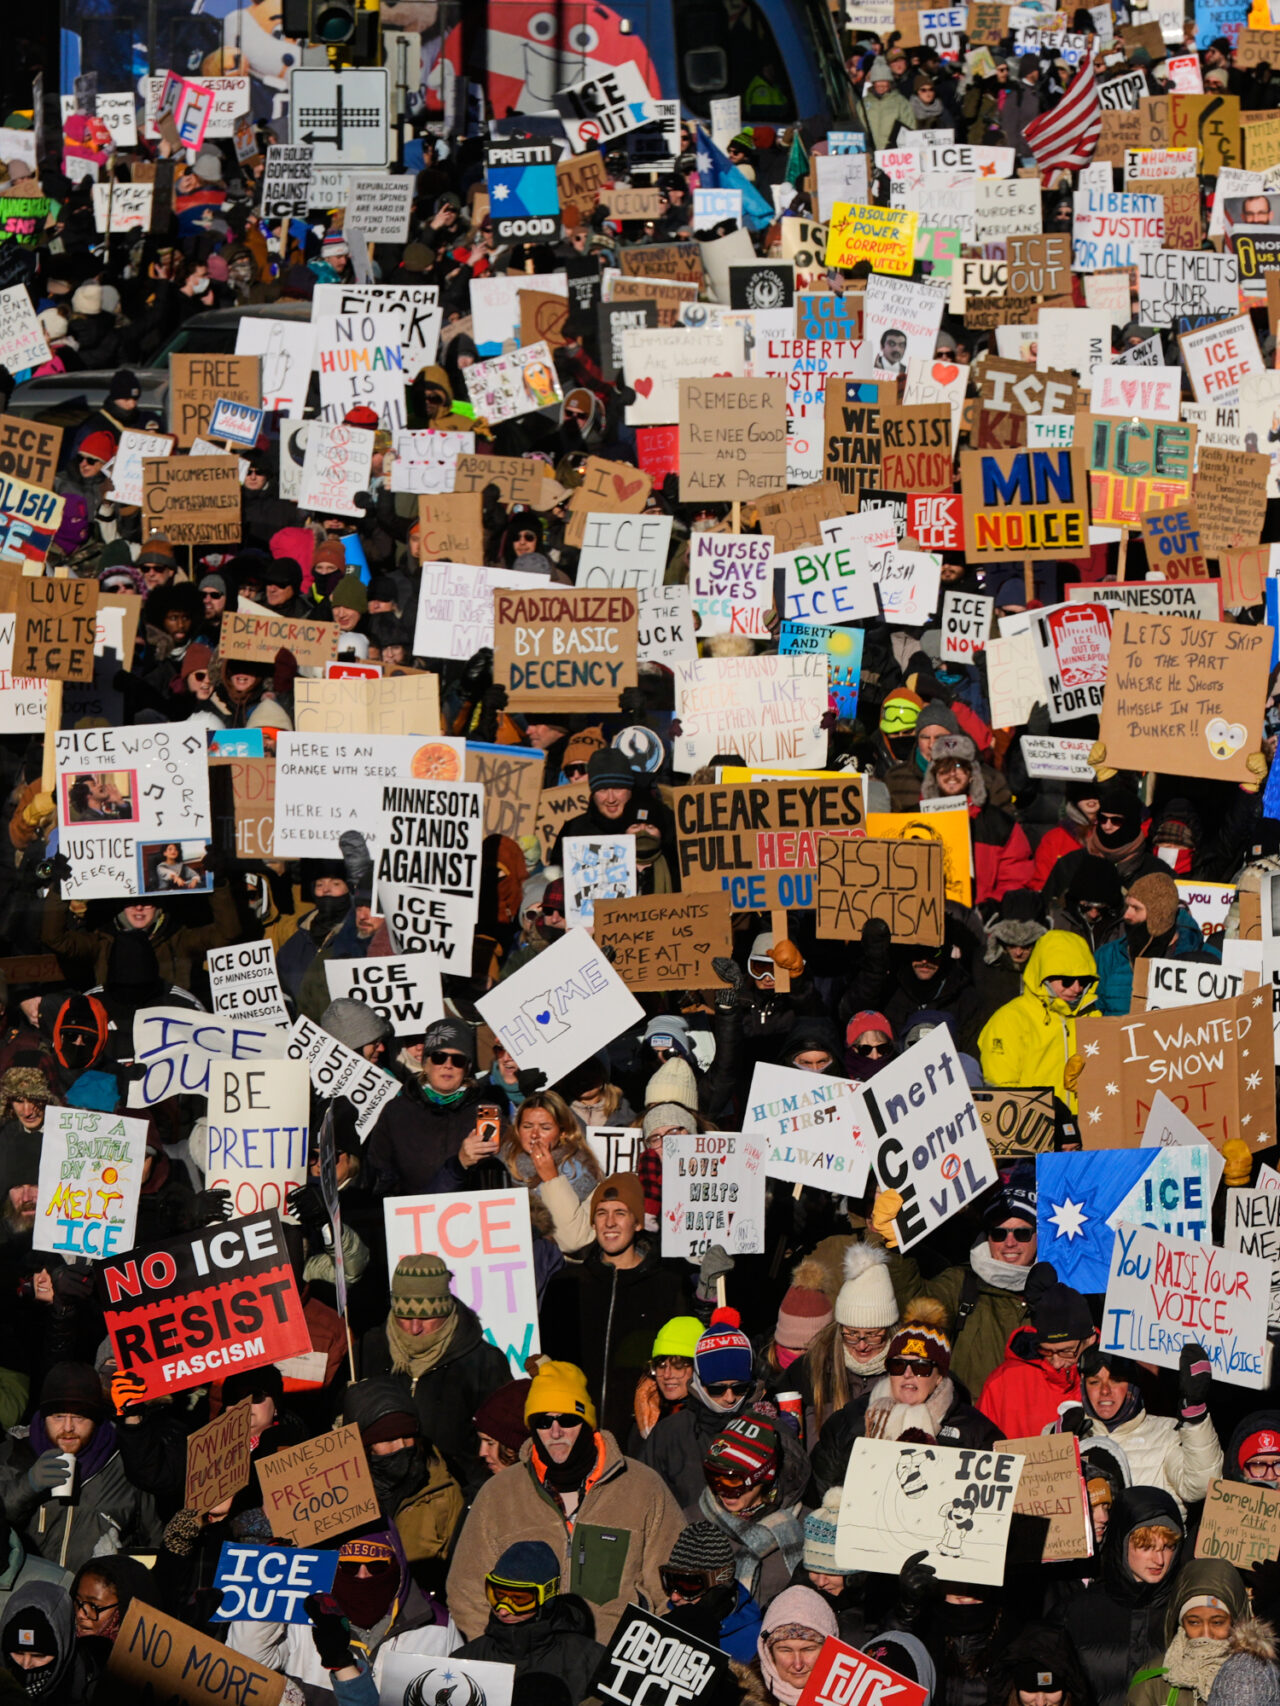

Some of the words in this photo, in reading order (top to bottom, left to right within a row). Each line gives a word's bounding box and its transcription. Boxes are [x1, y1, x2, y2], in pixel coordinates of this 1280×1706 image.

[1102, 74, 1147, 109] STOP
[488, 146, 552, 165] PRETTI
[932, 148, 972, 168] ICE
[267, 163, 311, 178] GOPHERS
[265, 183, 308, 199] AGAINST
[357, 183, 409, 191] REPUBLICANS
[264, 202, 307, 216] ICE
[1089, 192, 1156, 212] LIBERTY
[499, 219, 555, 237] GOOD
[1092, 217, 1165, 238] JUSTICE
[1010, 239, 1064, 267] ICE
[1073, 241, 1100, 267] FOR
[1102, 241, 1136, 267] ALL
[1011, 267, 1060, 294] OUT
[1140, 253, 1178, 278] ICE
[1180, 253, 1237, 283] MELTS
[335, 316, 375, 343] NO
[320, 345, 402, 374] HUMAN
[768, 340, 862, 359] LIBERTY
[1204, 339, 1239, 366] ICE
[190, 359, 240, 387] FREE
[1204, 361, 1252, 394] FREE
[687, 387, 773, 410] REMEBER
[690, 423, 744, 443] RENEE
[747, 422, 784, 443] GOOD
[883, 418, 951, 448] RESIST
[716, 448, 746, 461] AND
[687, 473, 729, 489] ALEX
[737, 471, 785, 489] PRETTI
[883, 453, 951, 489] FASCISM
[981, 452, 1074, 506] MN
[1146, 511, 1191, 536] ICE
[1158, 532, 1200, 555] OUT
[31, 583, 86, 605] LOVE
[951, 597, 985, 618] ICE
[499, 597, 635, 624] RADICALIZED
[26, 618, 96, 644] MELTS
[233, 614, 326, 643] DEMOCRACY
[948, 618, 984, 634] OUT
[515, 628, 544, 656] BY
[552, 627, 619, 654] BASIC
[946, 635, 985, 653] NOW
[26, 647, 85, 673] ICE
[510, 661, 624, 689] DECENCY
[716, 728, 806, 762] HAIRLINE
[383, 786, 480, 819] MINNESOTA
[677, 790, 772, 834] CLEAR
[778, 785, 861, 829] EYES
[391, 816, 469, 850] STANDS
[378, 848, 477, 888] AGAINST
[603, 905, 709, 926] IMMIGRANTS
[210, 953, 234, 973] ICE
[240, 947, 272, 967] OUT
[1121, 1023, 1150, 1063] I
[1153, 1016, 1252, 1051] WANTED
[1146, 1049, 1224, 1084] SNOW
[224, 1071, 270, 1113] BE
[694, 1137, 737, 1155] HOPE
[678, 1157, 719, 1177] LOVE
[690, 1182, 739, 1202] MELTS
[686, 1210, 735, 1237] HATE!
[104, 1251, 177, 1303] NO
[190, 1219, 279, 1276] ICE
[1155, 1241, 1200, 1289] RAISE
[1200, 1249, 1252, 1301] YOUR
[115, 1279, 293, 1369] RESIST
[1150, 1285, 1234, 1336] VOICE,
[162, 1336, 266, 1383] FASCISM
[955, 1451, 1015, 1482] ICE
[271, 1460, 362, 1511] PRETTI
[963, 1483, 1013, 1511] OUT
[221, 1548, 319, 1586] ICE
[129, 1616, 172, 1668] NO
[182, 1648, 268, 1701] MORE
